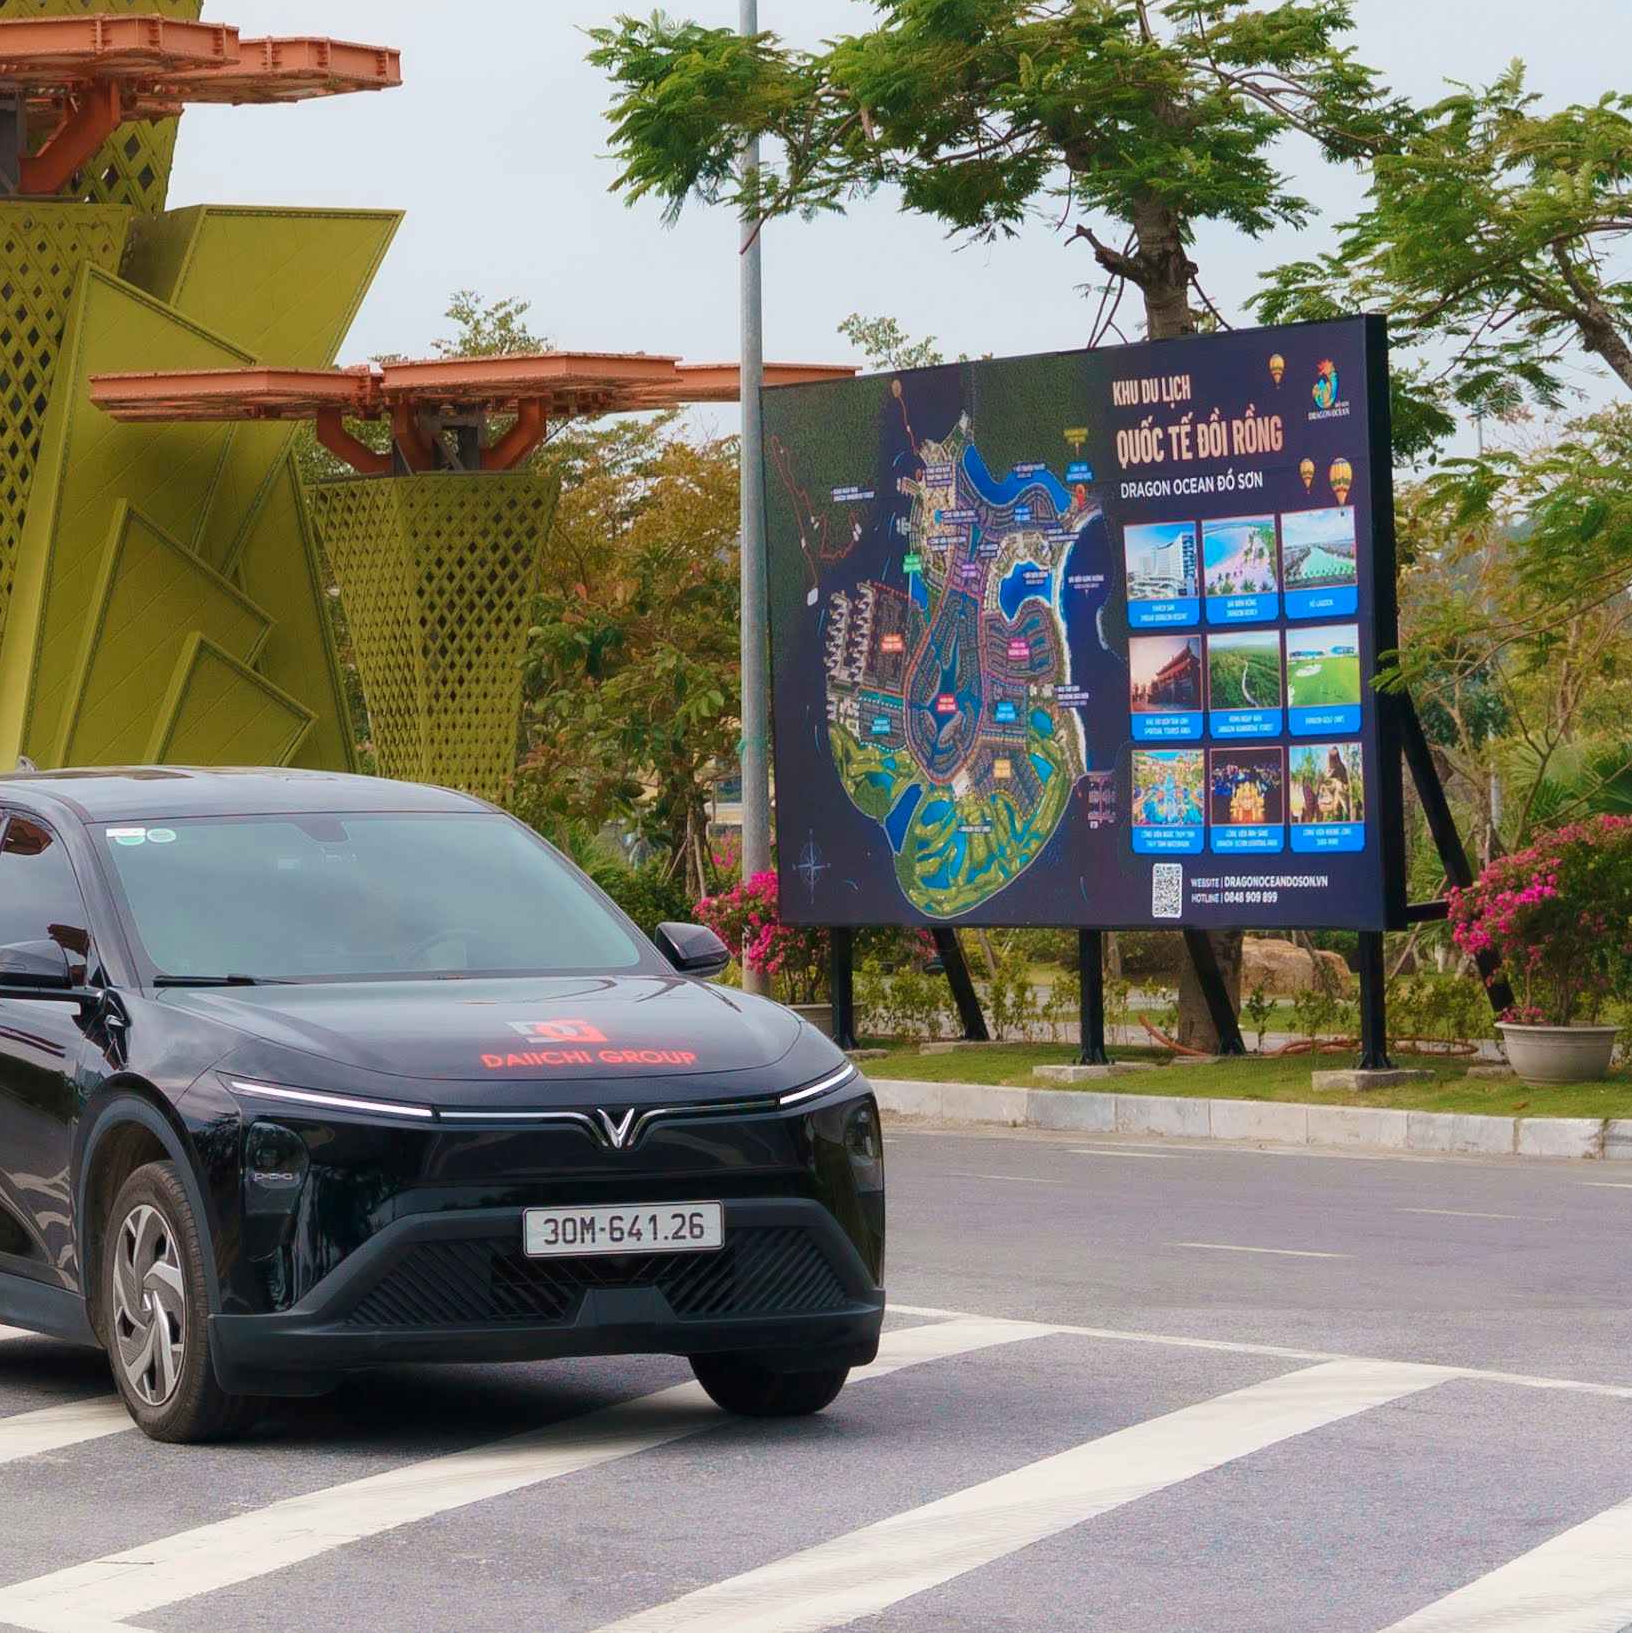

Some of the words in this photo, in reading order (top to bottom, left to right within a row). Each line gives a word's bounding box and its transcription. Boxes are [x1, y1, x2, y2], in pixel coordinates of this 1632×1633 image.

[1113, 379, 1137, 407] KHU
[1142, 377, 1160, 404] DU
[1162, 374, 1192, 409] LỊCH
[1116, 414, 1164, 469] QUỐC
[1168, 411, 1194, 462] TẾ
[1196, 406, 1229, 459] ĐỒI
[1232, 403, 1284, 456] RỒNG
[1120, 479, 1171, 499] DRAGON
[1173, 476, 1215, 496] OCEAN
[1238, 471, 1263, 490] SƠN
[1191, 878, 1220, 888] WEBSITE
[1224, 875, 1328, 888] DRAGONOCEANDOSON.VN
[1191, 893, 1220, 904] HOTLINE
[480, 1051, 595, 1070] DAIICHI
[598, 1049, 698, 1066] GROUP
[543, 1212, 705, 1246] 30M-641.26
